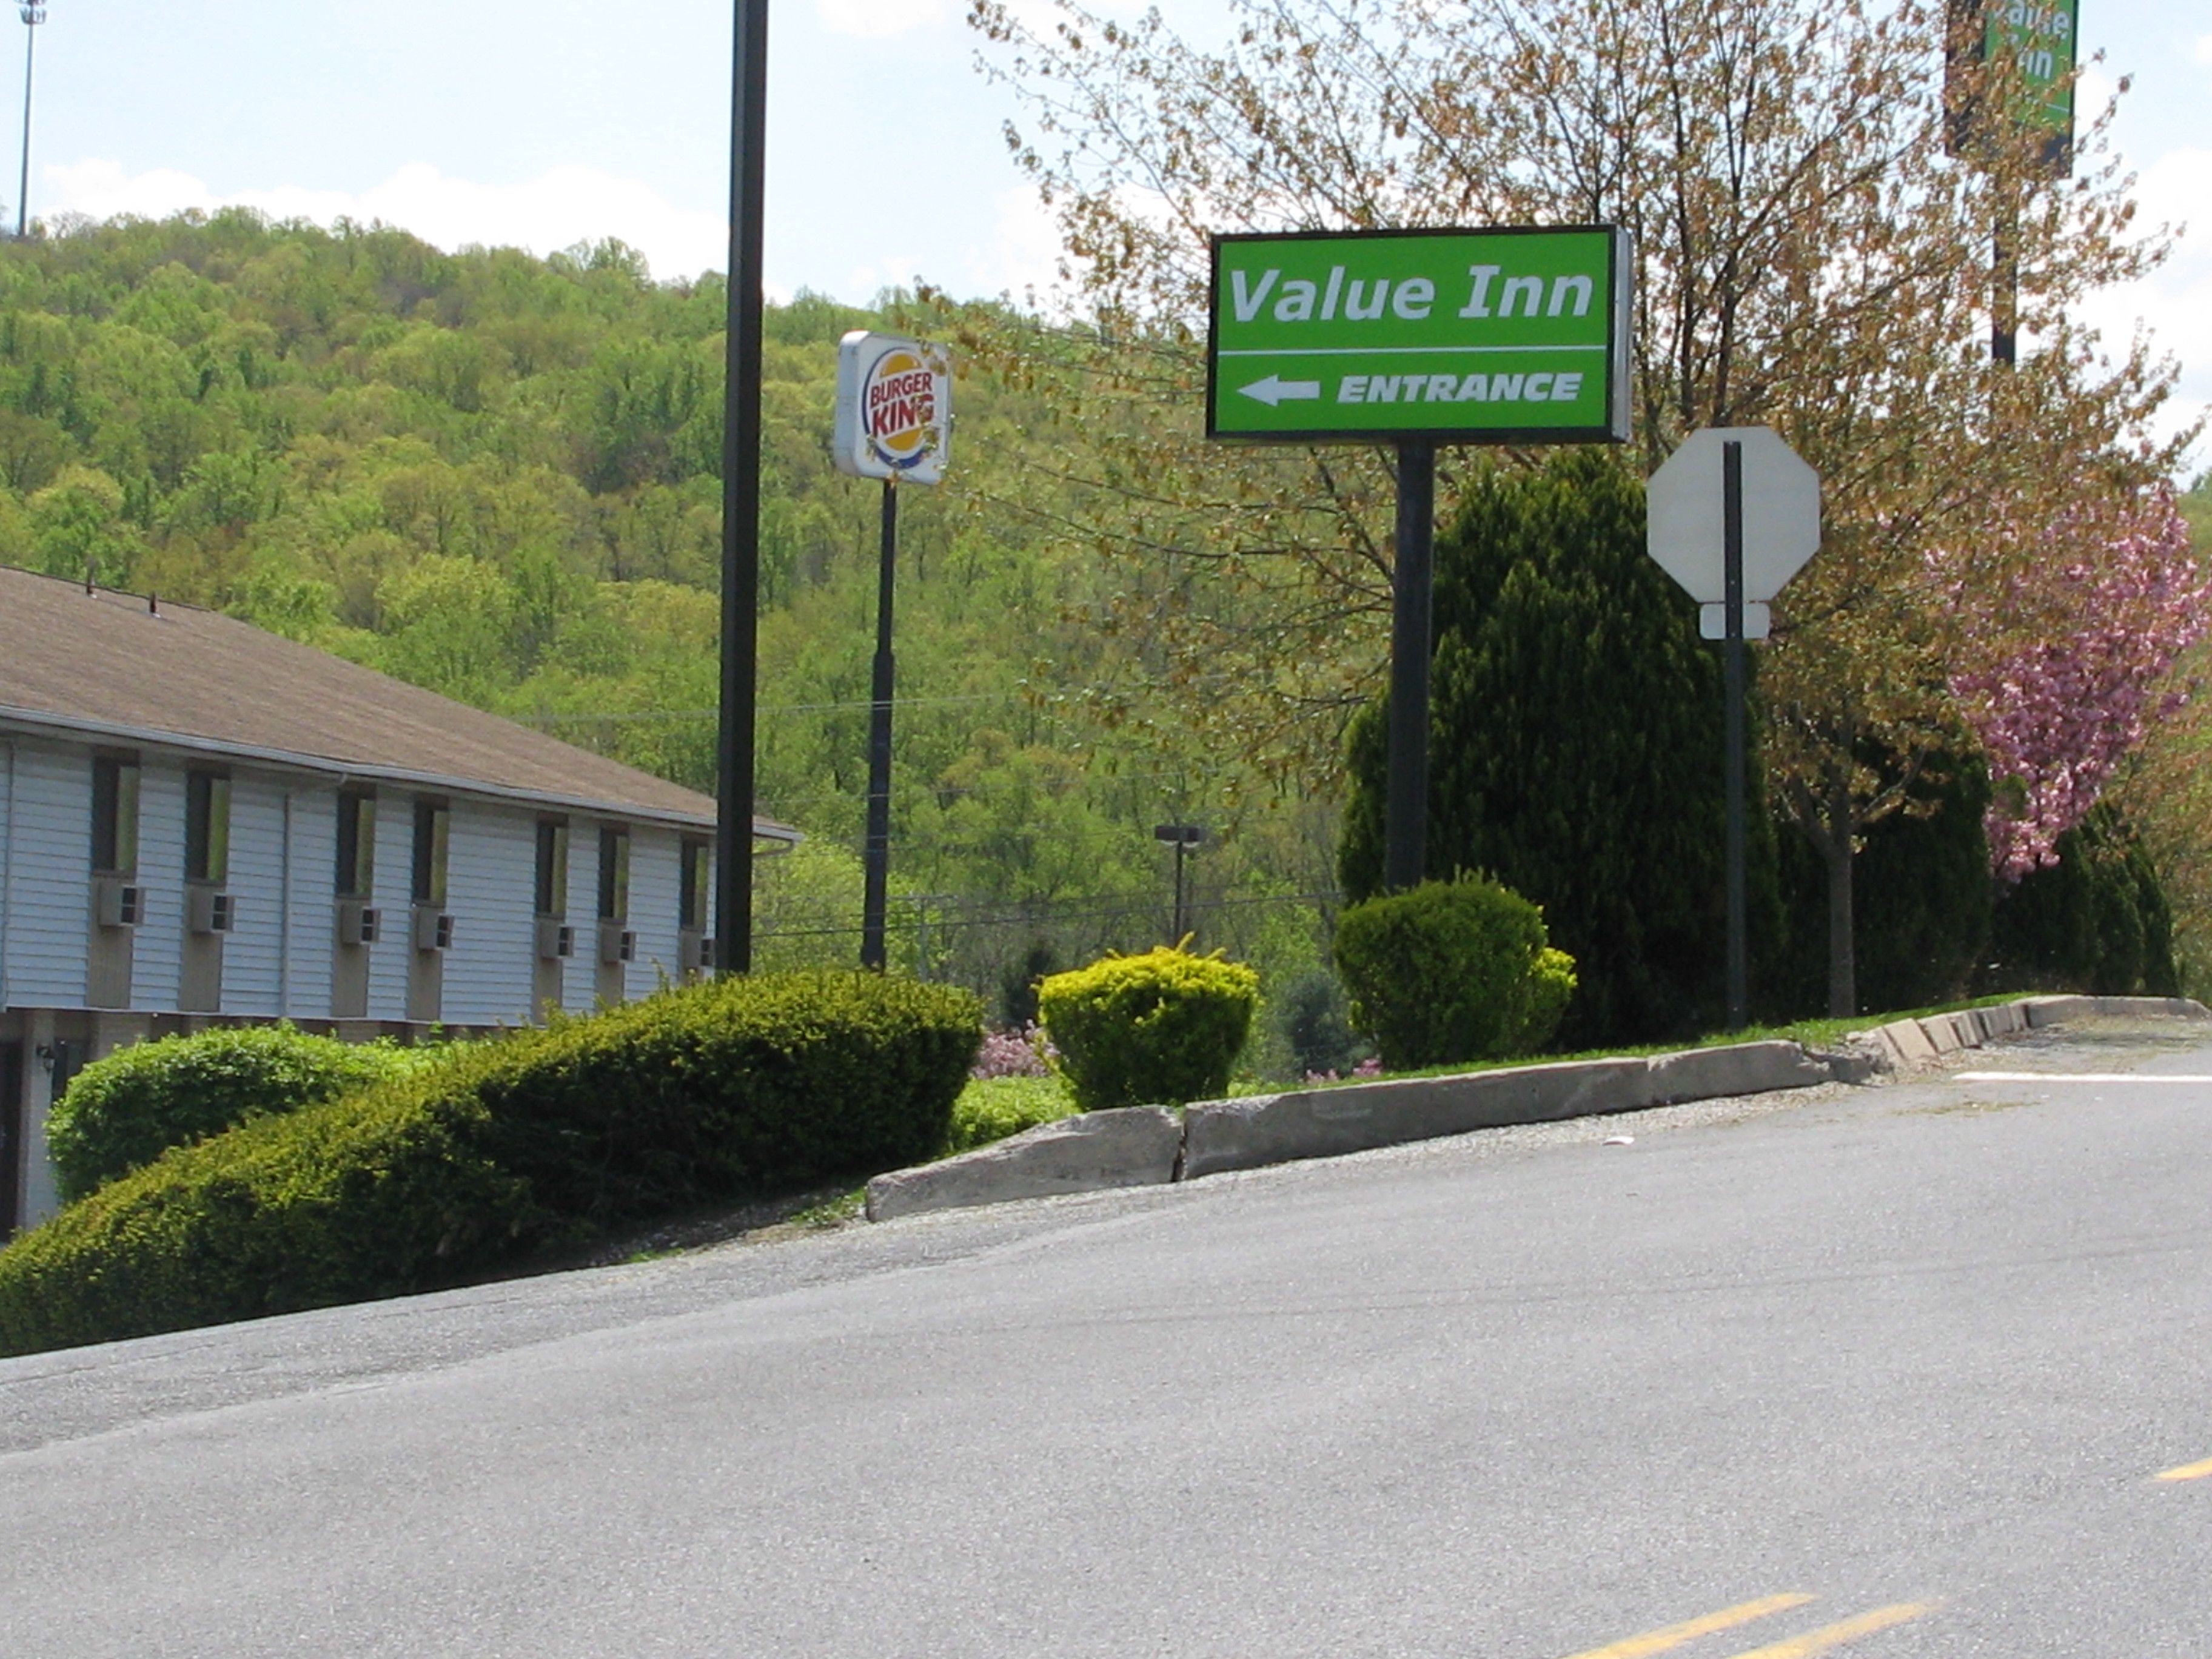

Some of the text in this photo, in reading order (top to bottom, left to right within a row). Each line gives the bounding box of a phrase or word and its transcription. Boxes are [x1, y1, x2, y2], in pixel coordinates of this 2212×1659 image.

[1231, 264, 1594, 323] Value Inn
[870, 372, 933, 409] BURGER
[1337, 372, 1583, 404] ENTRANCE
